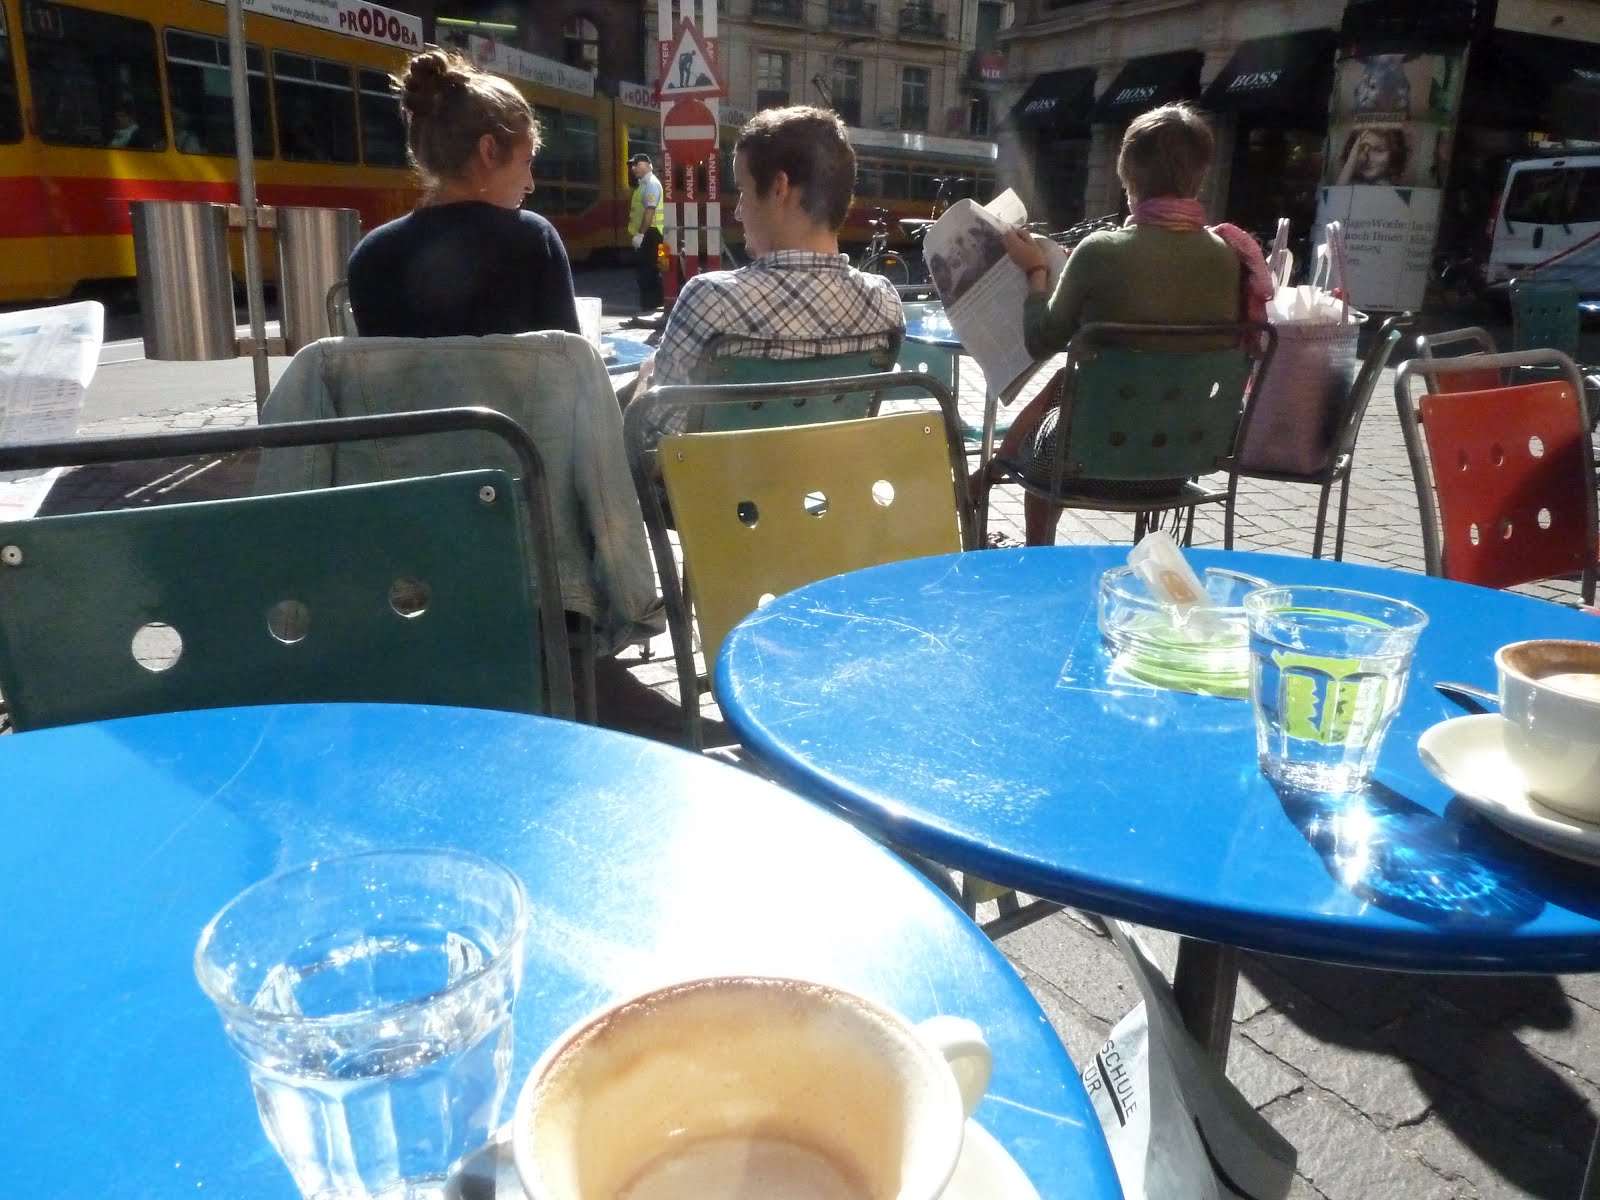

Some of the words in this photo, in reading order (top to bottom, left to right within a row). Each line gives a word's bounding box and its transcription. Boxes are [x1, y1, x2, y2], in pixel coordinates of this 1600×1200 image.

[339, 7, 418, 47] PRODOBA
[1115, 85, 1158, 101] BOSS
[1229, 69, 1282, 89] BOSS
[664, 152, 673, 200] ANLIKER
[686, 164, 694, 200] ANLIK
[708, 152, 717, 200] ANLIKER
[1101, 1040, 1138, 1119] SCHULE
